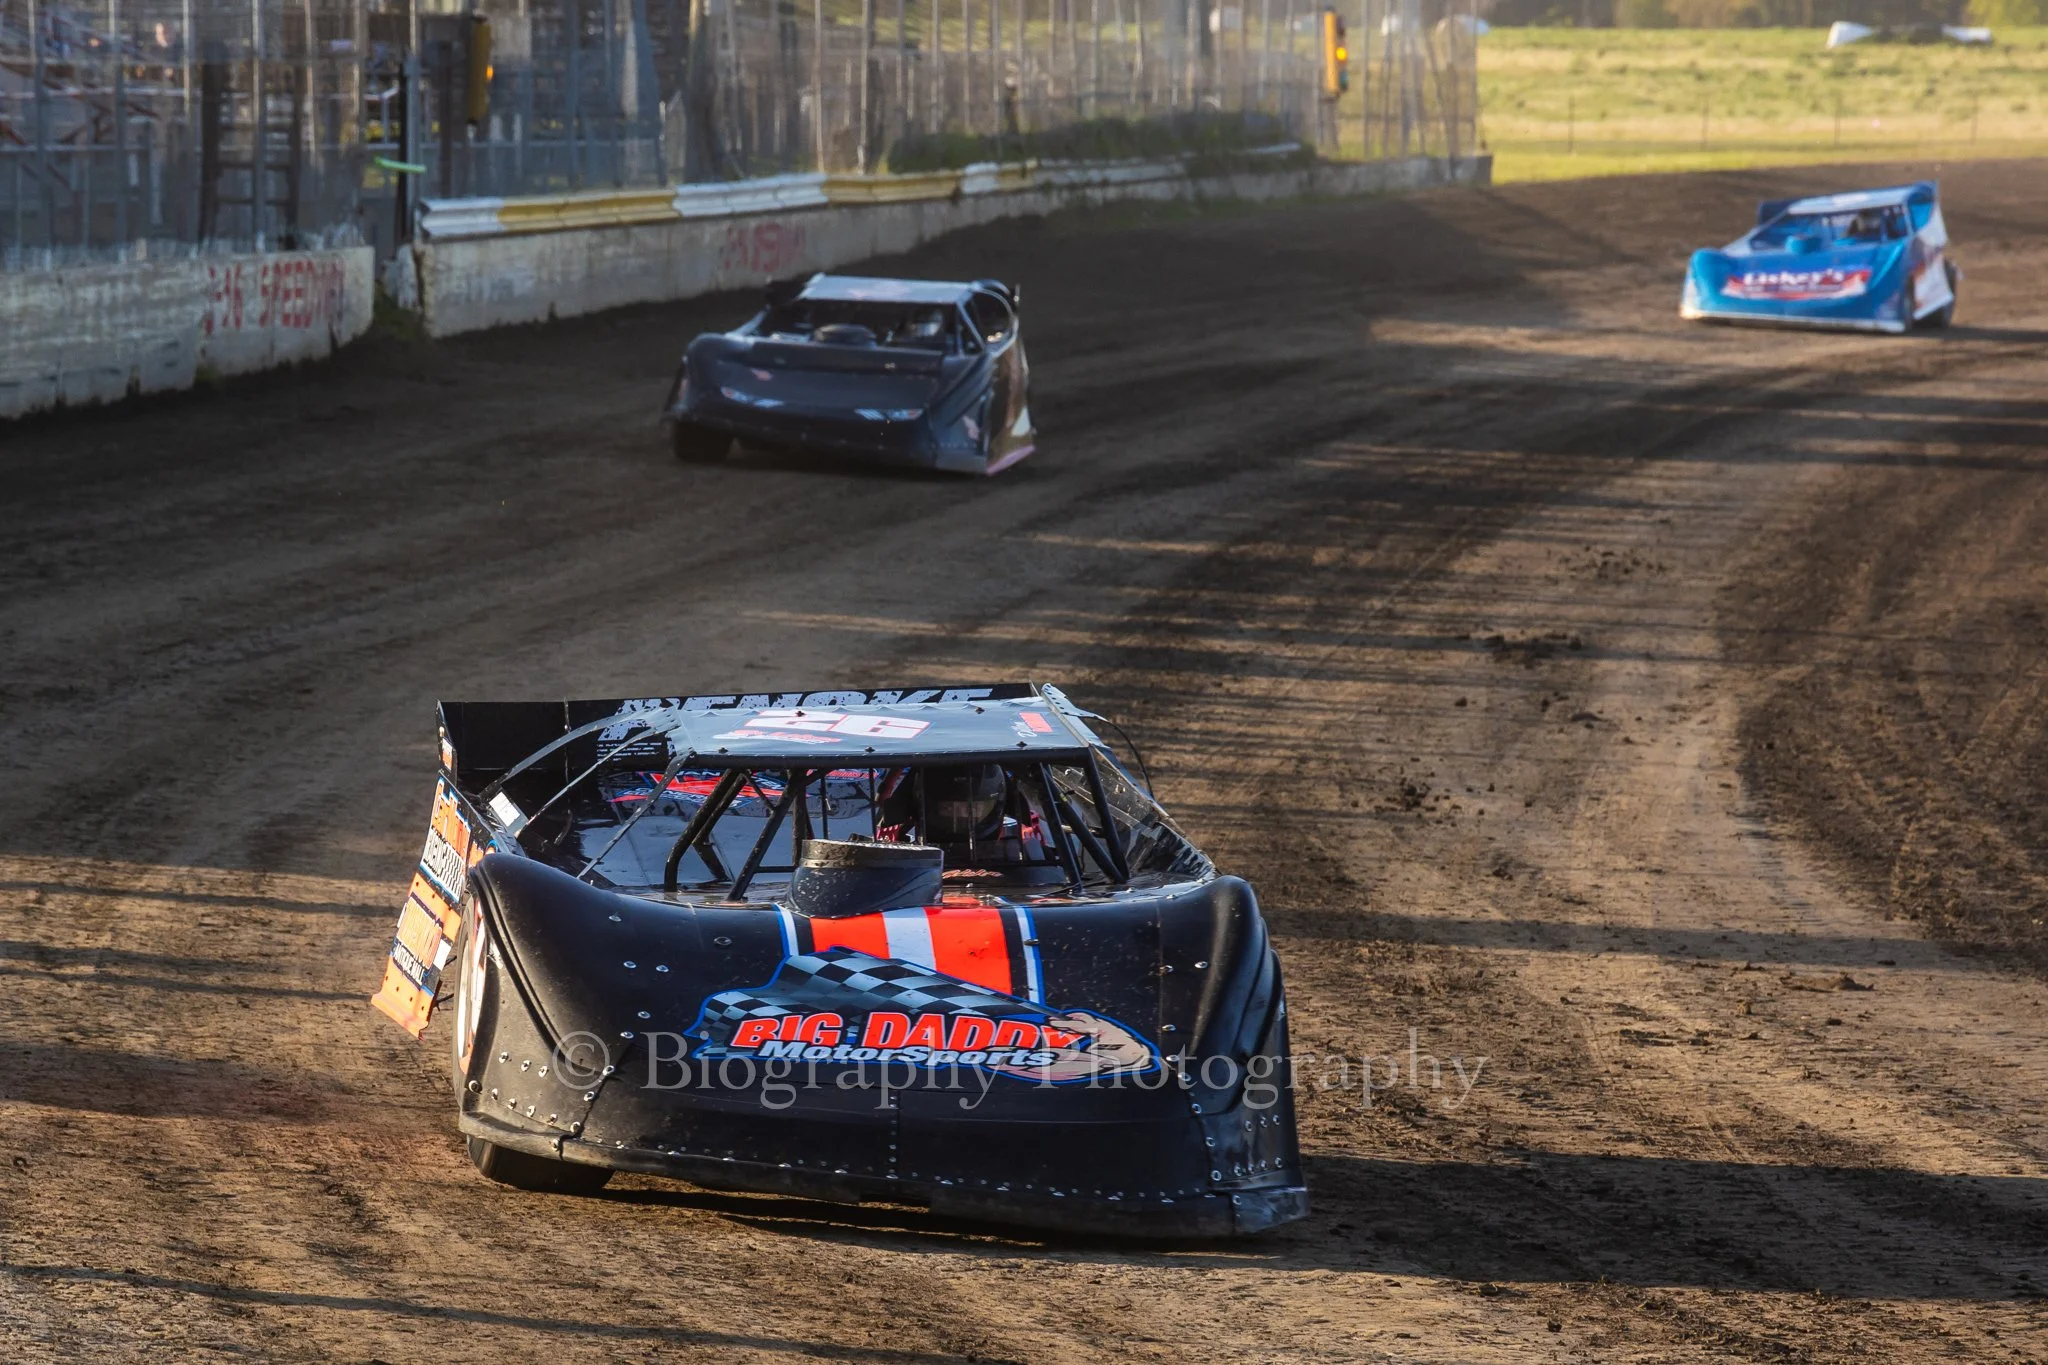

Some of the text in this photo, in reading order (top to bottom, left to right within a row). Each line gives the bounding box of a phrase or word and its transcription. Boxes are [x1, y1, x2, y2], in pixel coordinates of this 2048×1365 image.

[730, 1012, 1087, 1050] BIG DADDY
[757, 1040, 1056, 1067] MotorSports
